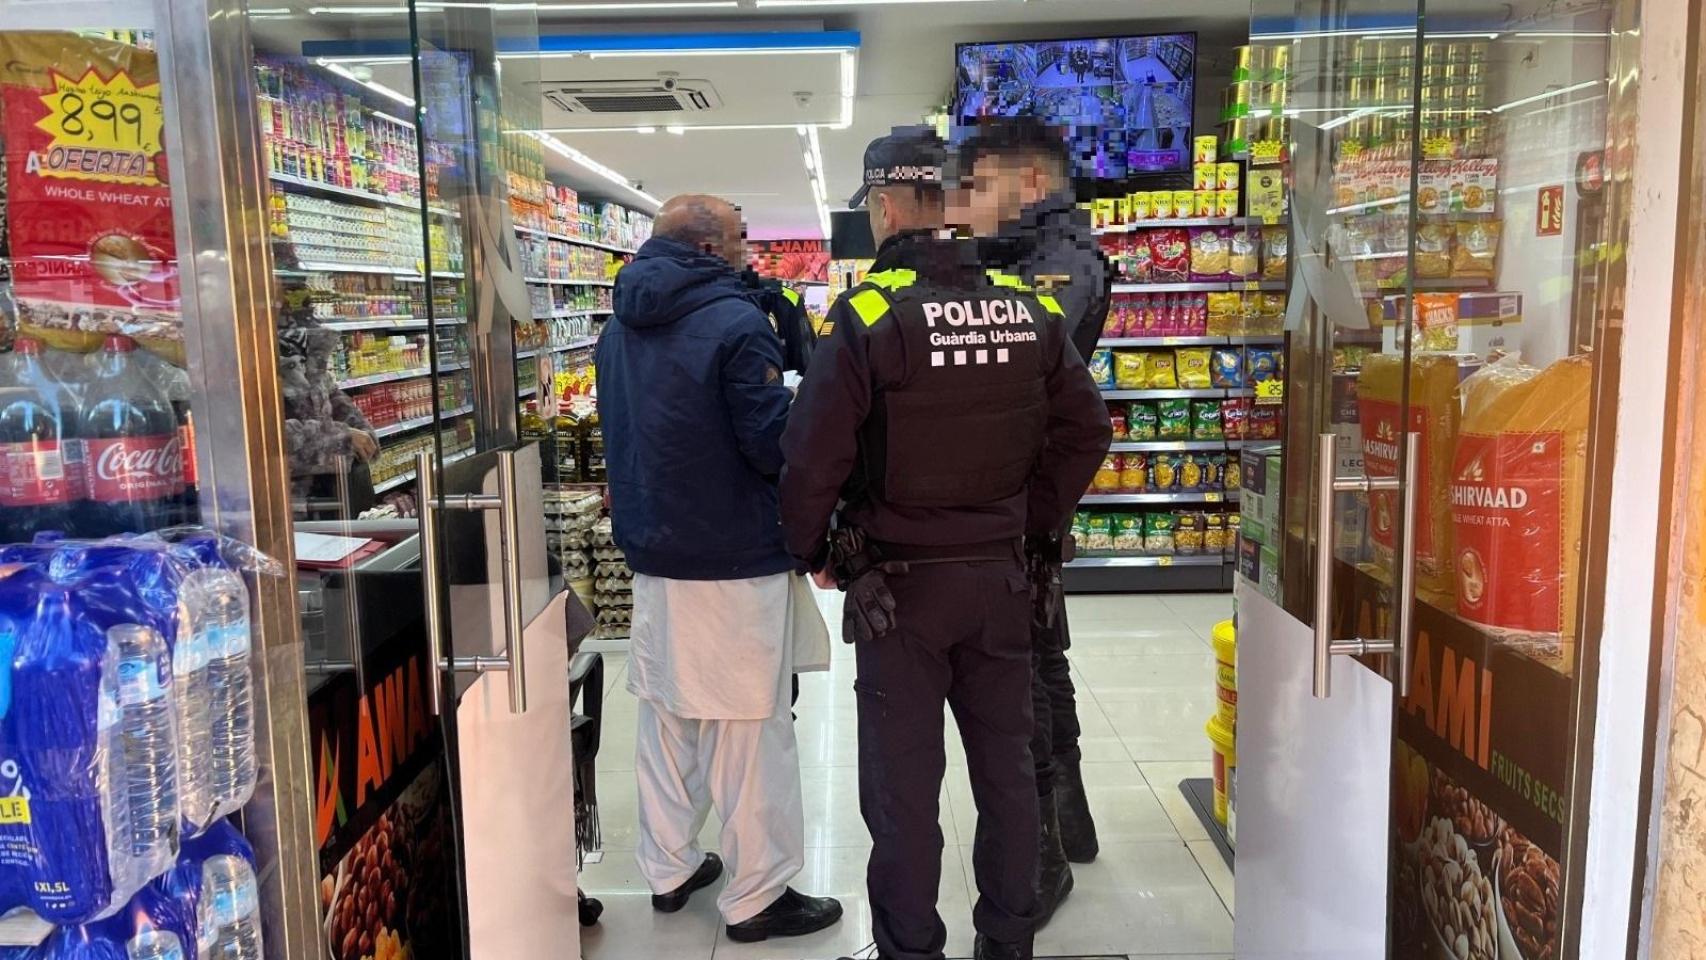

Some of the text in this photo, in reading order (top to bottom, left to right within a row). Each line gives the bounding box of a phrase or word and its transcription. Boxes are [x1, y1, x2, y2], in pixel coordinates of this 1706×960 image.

[61, 92, 142, 146] 8,99
[49, 146, 146, 174] OFERTA
[45, 186, 95, 201] WHOLE
[98, 192, 149, 206] WHEAT
[922, 299, 1034, 327] POLICIA
[930, 329, 1037, 346] Guàrdia Urbana
[1486, 516, 1510, 527] ATTA
[1491, 751, 1565, 825] FRUITS SECS
